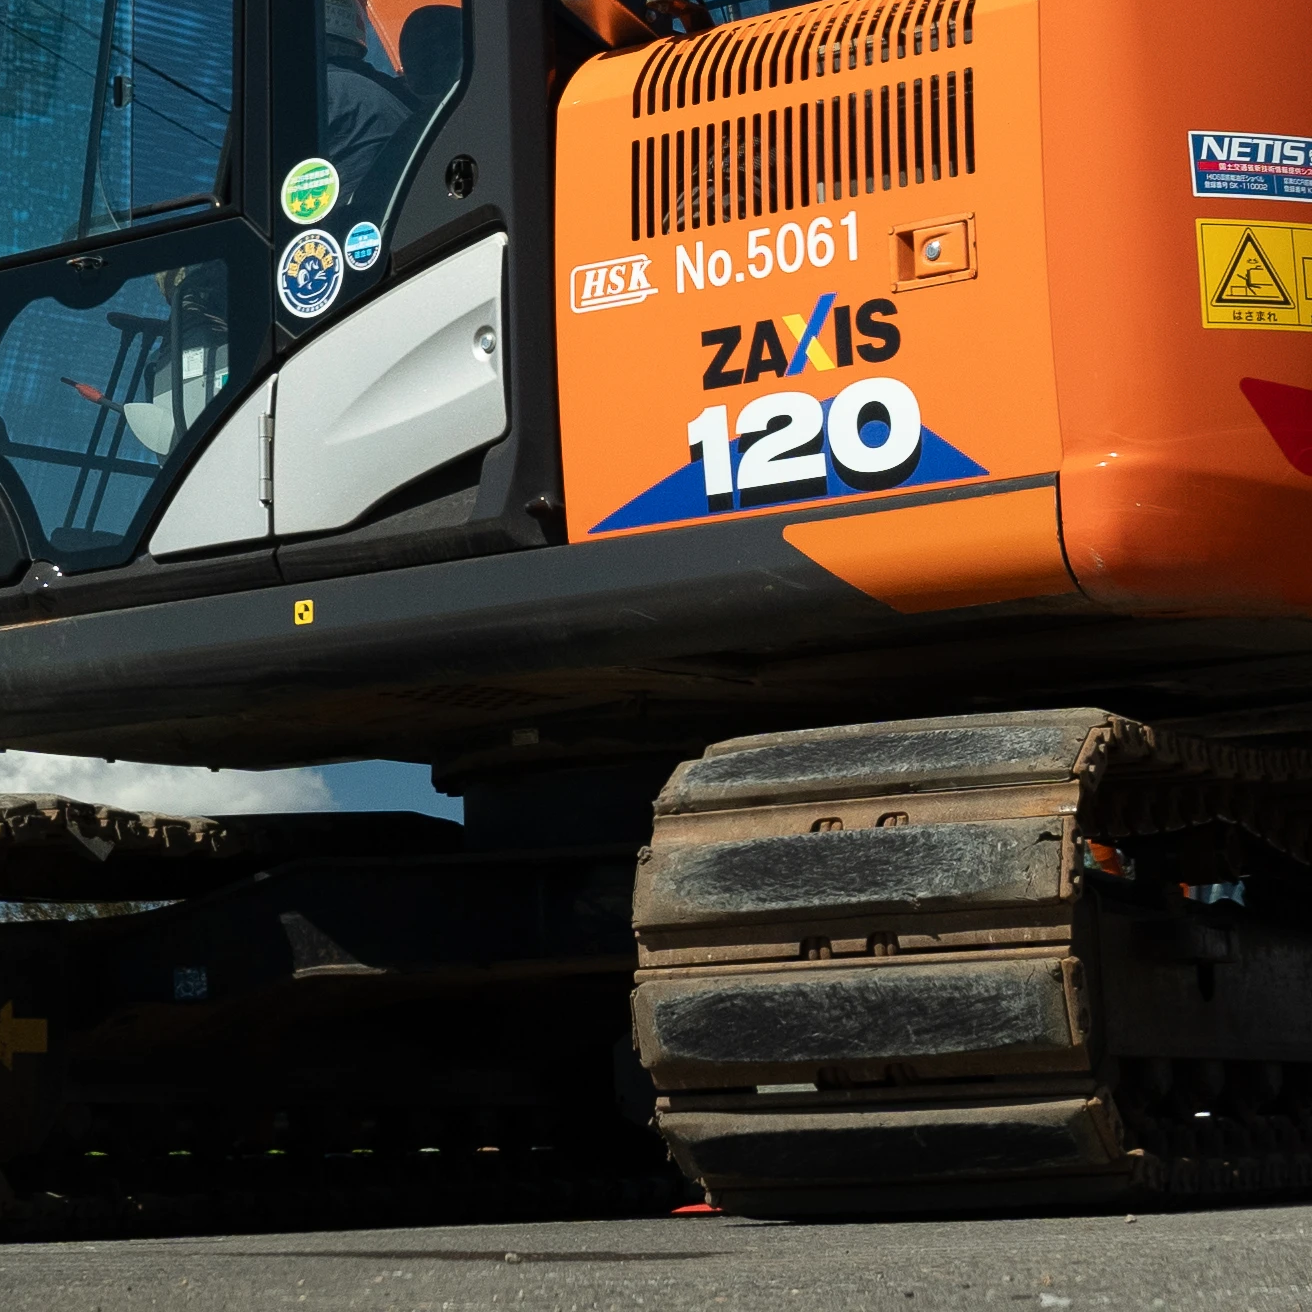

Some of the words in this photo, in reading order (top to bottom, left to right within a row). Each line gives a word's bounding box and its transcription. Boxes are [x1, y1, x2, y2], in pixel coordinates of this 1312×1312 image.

[1200, 136, 1305, 166] NETIS
[581, 260, 652, 300] HSK
[675, 210, 858, 294] No.5061
[701, 292, 901, 391] ZAXIS
[1233, 310, 1278, 322] はさまれ
[688, 377, 922, 513] 120
